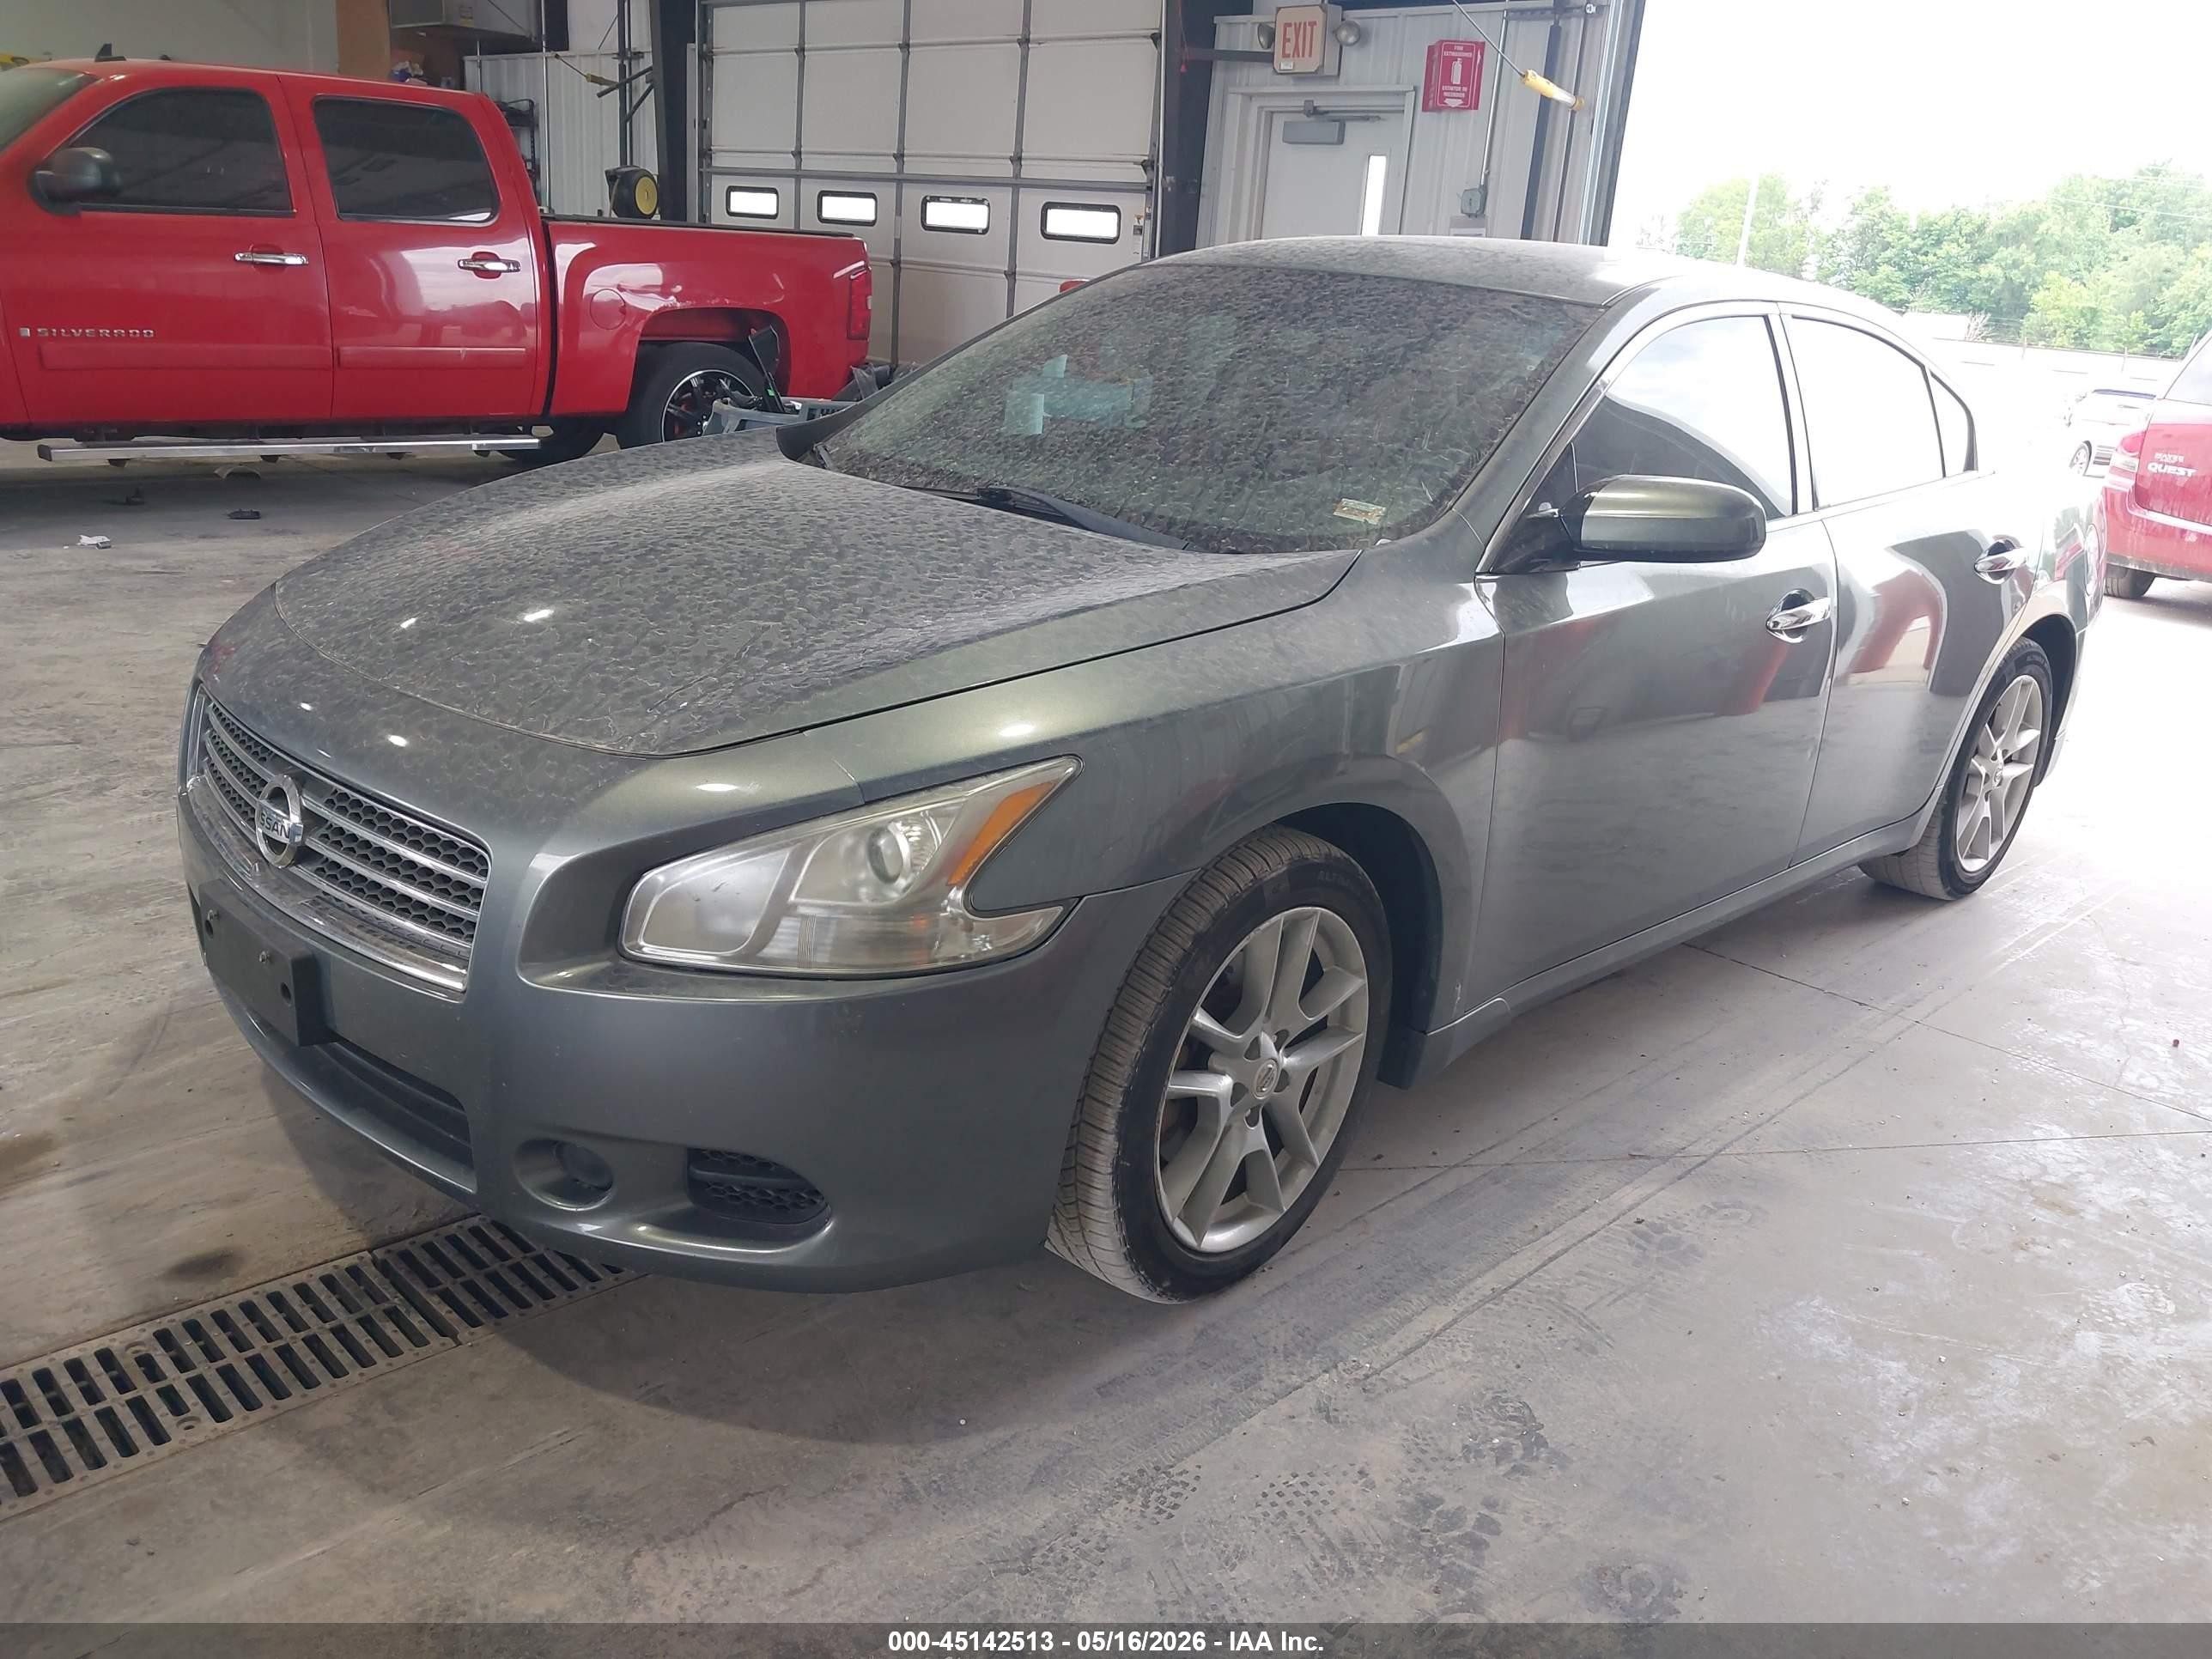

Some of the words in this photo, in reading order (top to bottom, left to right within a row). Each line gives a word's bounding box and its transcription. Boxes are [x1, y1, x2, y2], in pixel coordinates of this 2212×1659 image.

[1281, 21, 1318, 58] EXIT
[37, 328, 155, 337] SILVERADO
[2148, 462, 2197, 477] QUEST
